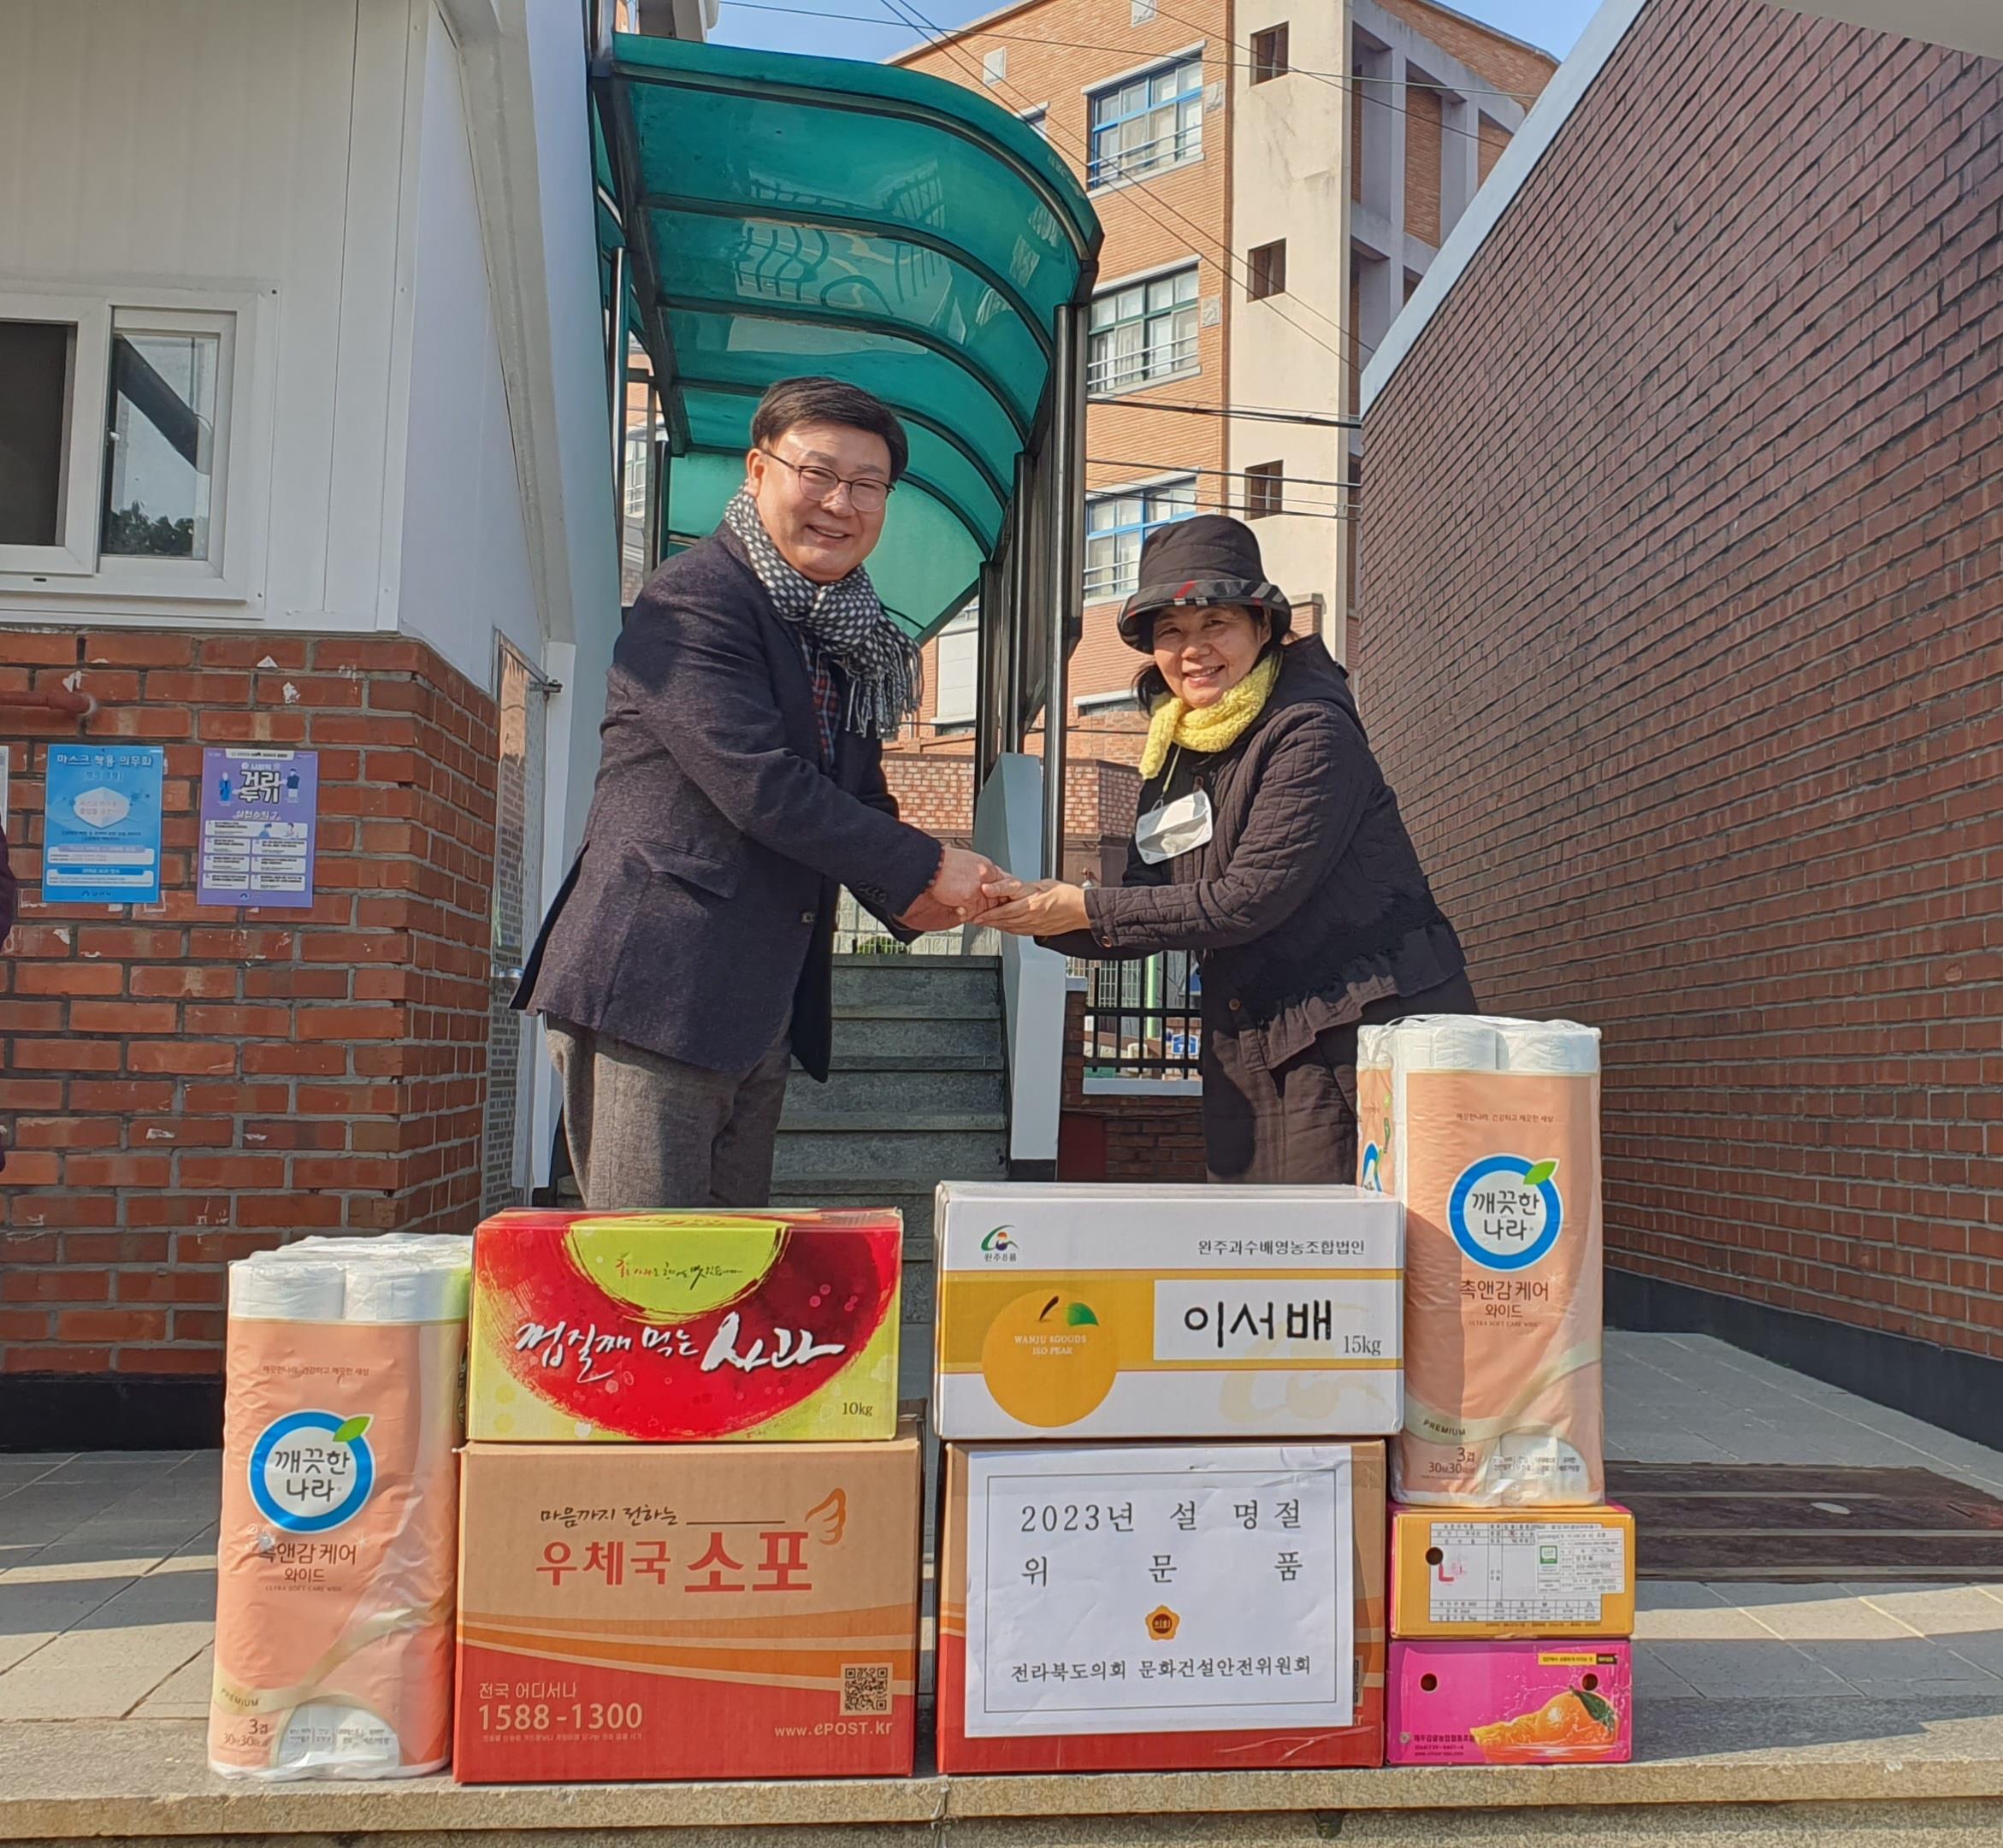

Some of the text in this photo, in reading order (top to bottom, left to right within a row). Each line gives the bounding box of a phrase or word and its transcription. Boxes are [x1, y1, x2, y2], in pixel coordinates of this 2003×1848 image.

[57, 755, 152, 767] 마스크 착용 의무화
[239, 770, 281, 788] 거리
[239, 788, 280, 804] 두기
[1472, 1190, 1540, 1218] 깨끗한
[1484, 1218, 1527, 1242] 나라
[1197, 1239, 1366, 1256] 완주과수배영농조합법인
[1459, 1279, 1549, 1302] 촉앤감 케어
[1485, 1303, 1524, 1318] 와이드
[1184, 1299, 1332, 1349] 이서배
[642, 1325, 700, 1357] 먹는
[700, 1311, 845, 1373] 사과
[1014, 1335, 1047, 1344] WANJU
[1342, 1335, 1382, 1356] 15kg
[1049, 1347, 1072, 1355] PEAR
[841, 1402, 873, 1417] 10kg
[1423, 1418, 1466, 1437] PREMIUM
[275, 1447, 351, 1475] 깨끗한
[287, 1479, 335, 1503] 나라
[540, 1503, 678, 1528] 마음까지 전하는
[1021, 1502, 1134, 1532] 2023년
[1169, 1500, 1197, 1531] 설
[318, 1545, 357, 1566] 케어
[535, 1531, 812, 1594] 우체국 소포
[284, 1569, 326, 1583] 와이드
[1011, 1656, 1311, 1684] 전라북도의회 문화건설안전위원회
[221, 1686, 261, 1708] PREMIUM
[479, 1681, 577, 1699] 전국 어디서나
